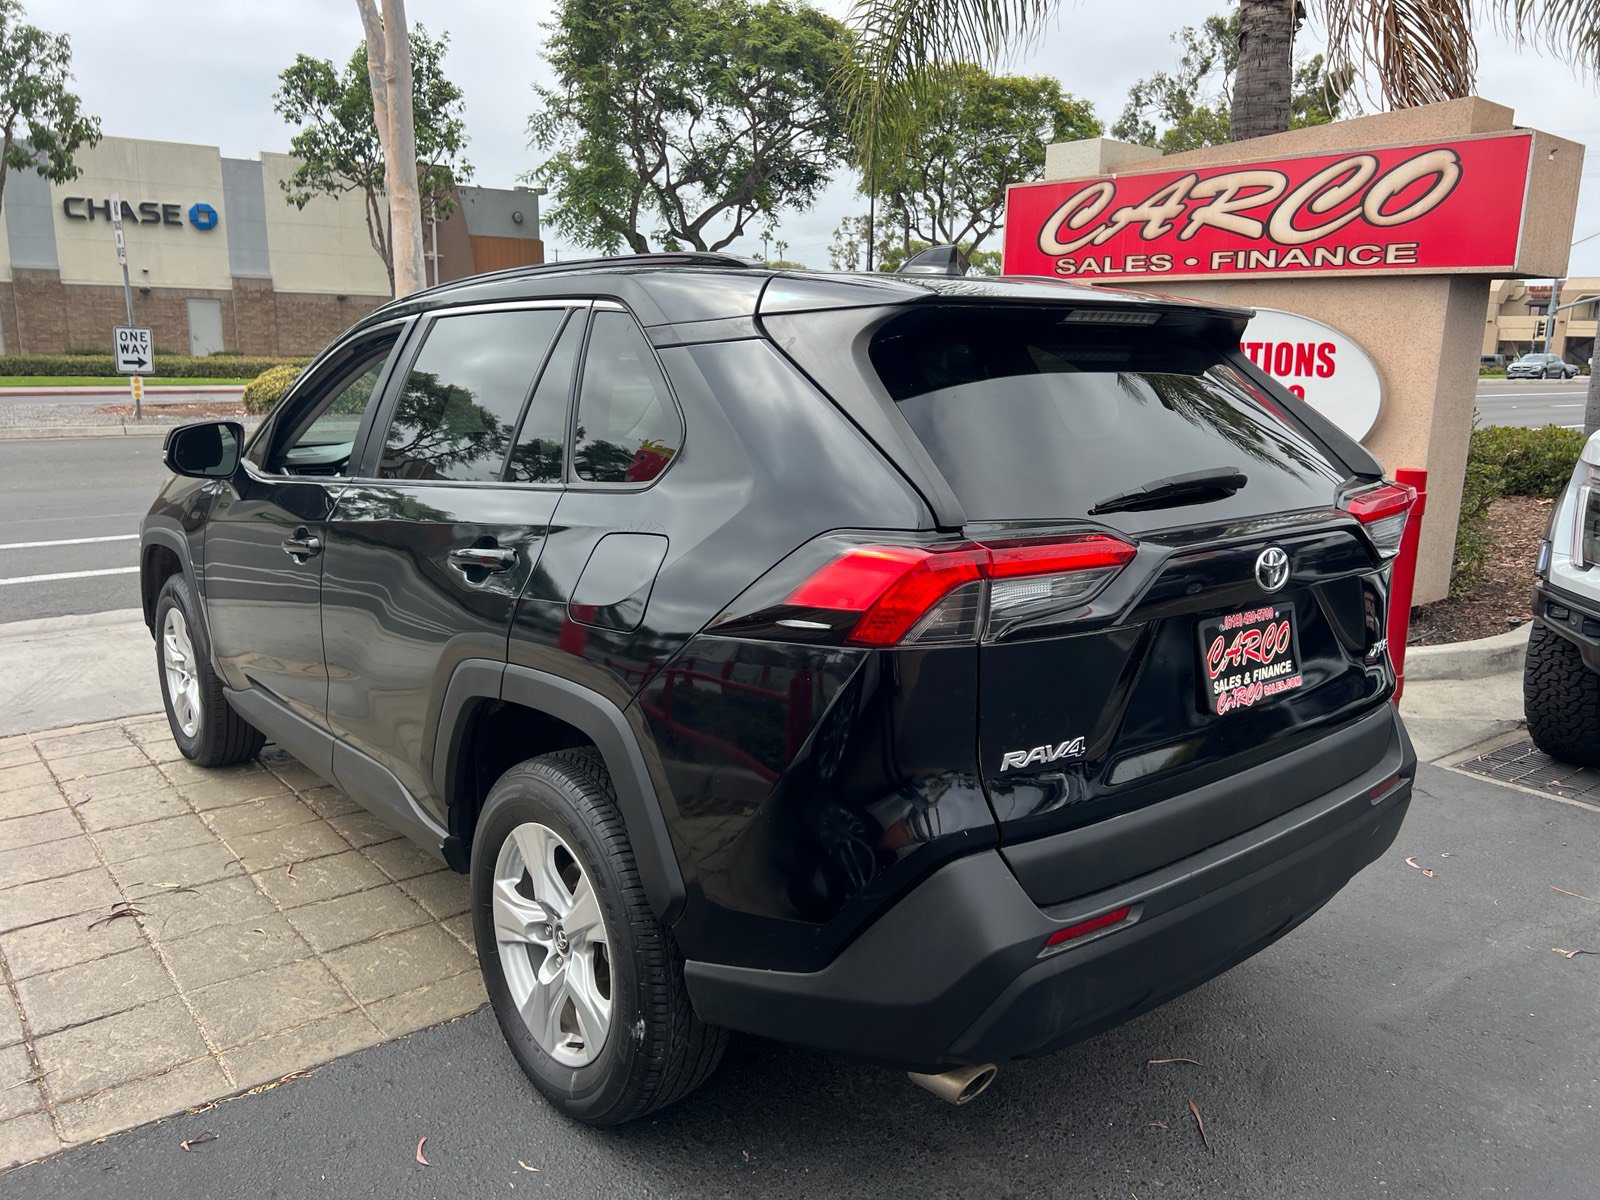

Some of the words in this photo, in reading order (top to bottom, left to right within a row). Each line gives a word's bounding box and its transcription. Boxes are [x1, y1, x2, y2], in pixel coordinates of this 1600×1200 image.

[63, 196, 183, 227] CHASE
[1038, 147, 1463, 257] CARCO
[1055, 253, 1174, 276] SALES
[1210, 242, 1420, 271] FINANCE
[119, 331, 147, 343] ONE
[120, 343, 148, 355] WAY
[1240, 342, 1336, 378] TIONS
[1207, 620, 1290, 679] CARCO
[1213, 674, 1242, 694] SALES
[1243, 672, 1250, 685] &
[1253, 660, 1292, 682] FINANCE
[1217, 681, 1263, 715] CARCO
[1000, 736, 1086, 772] RAV4
